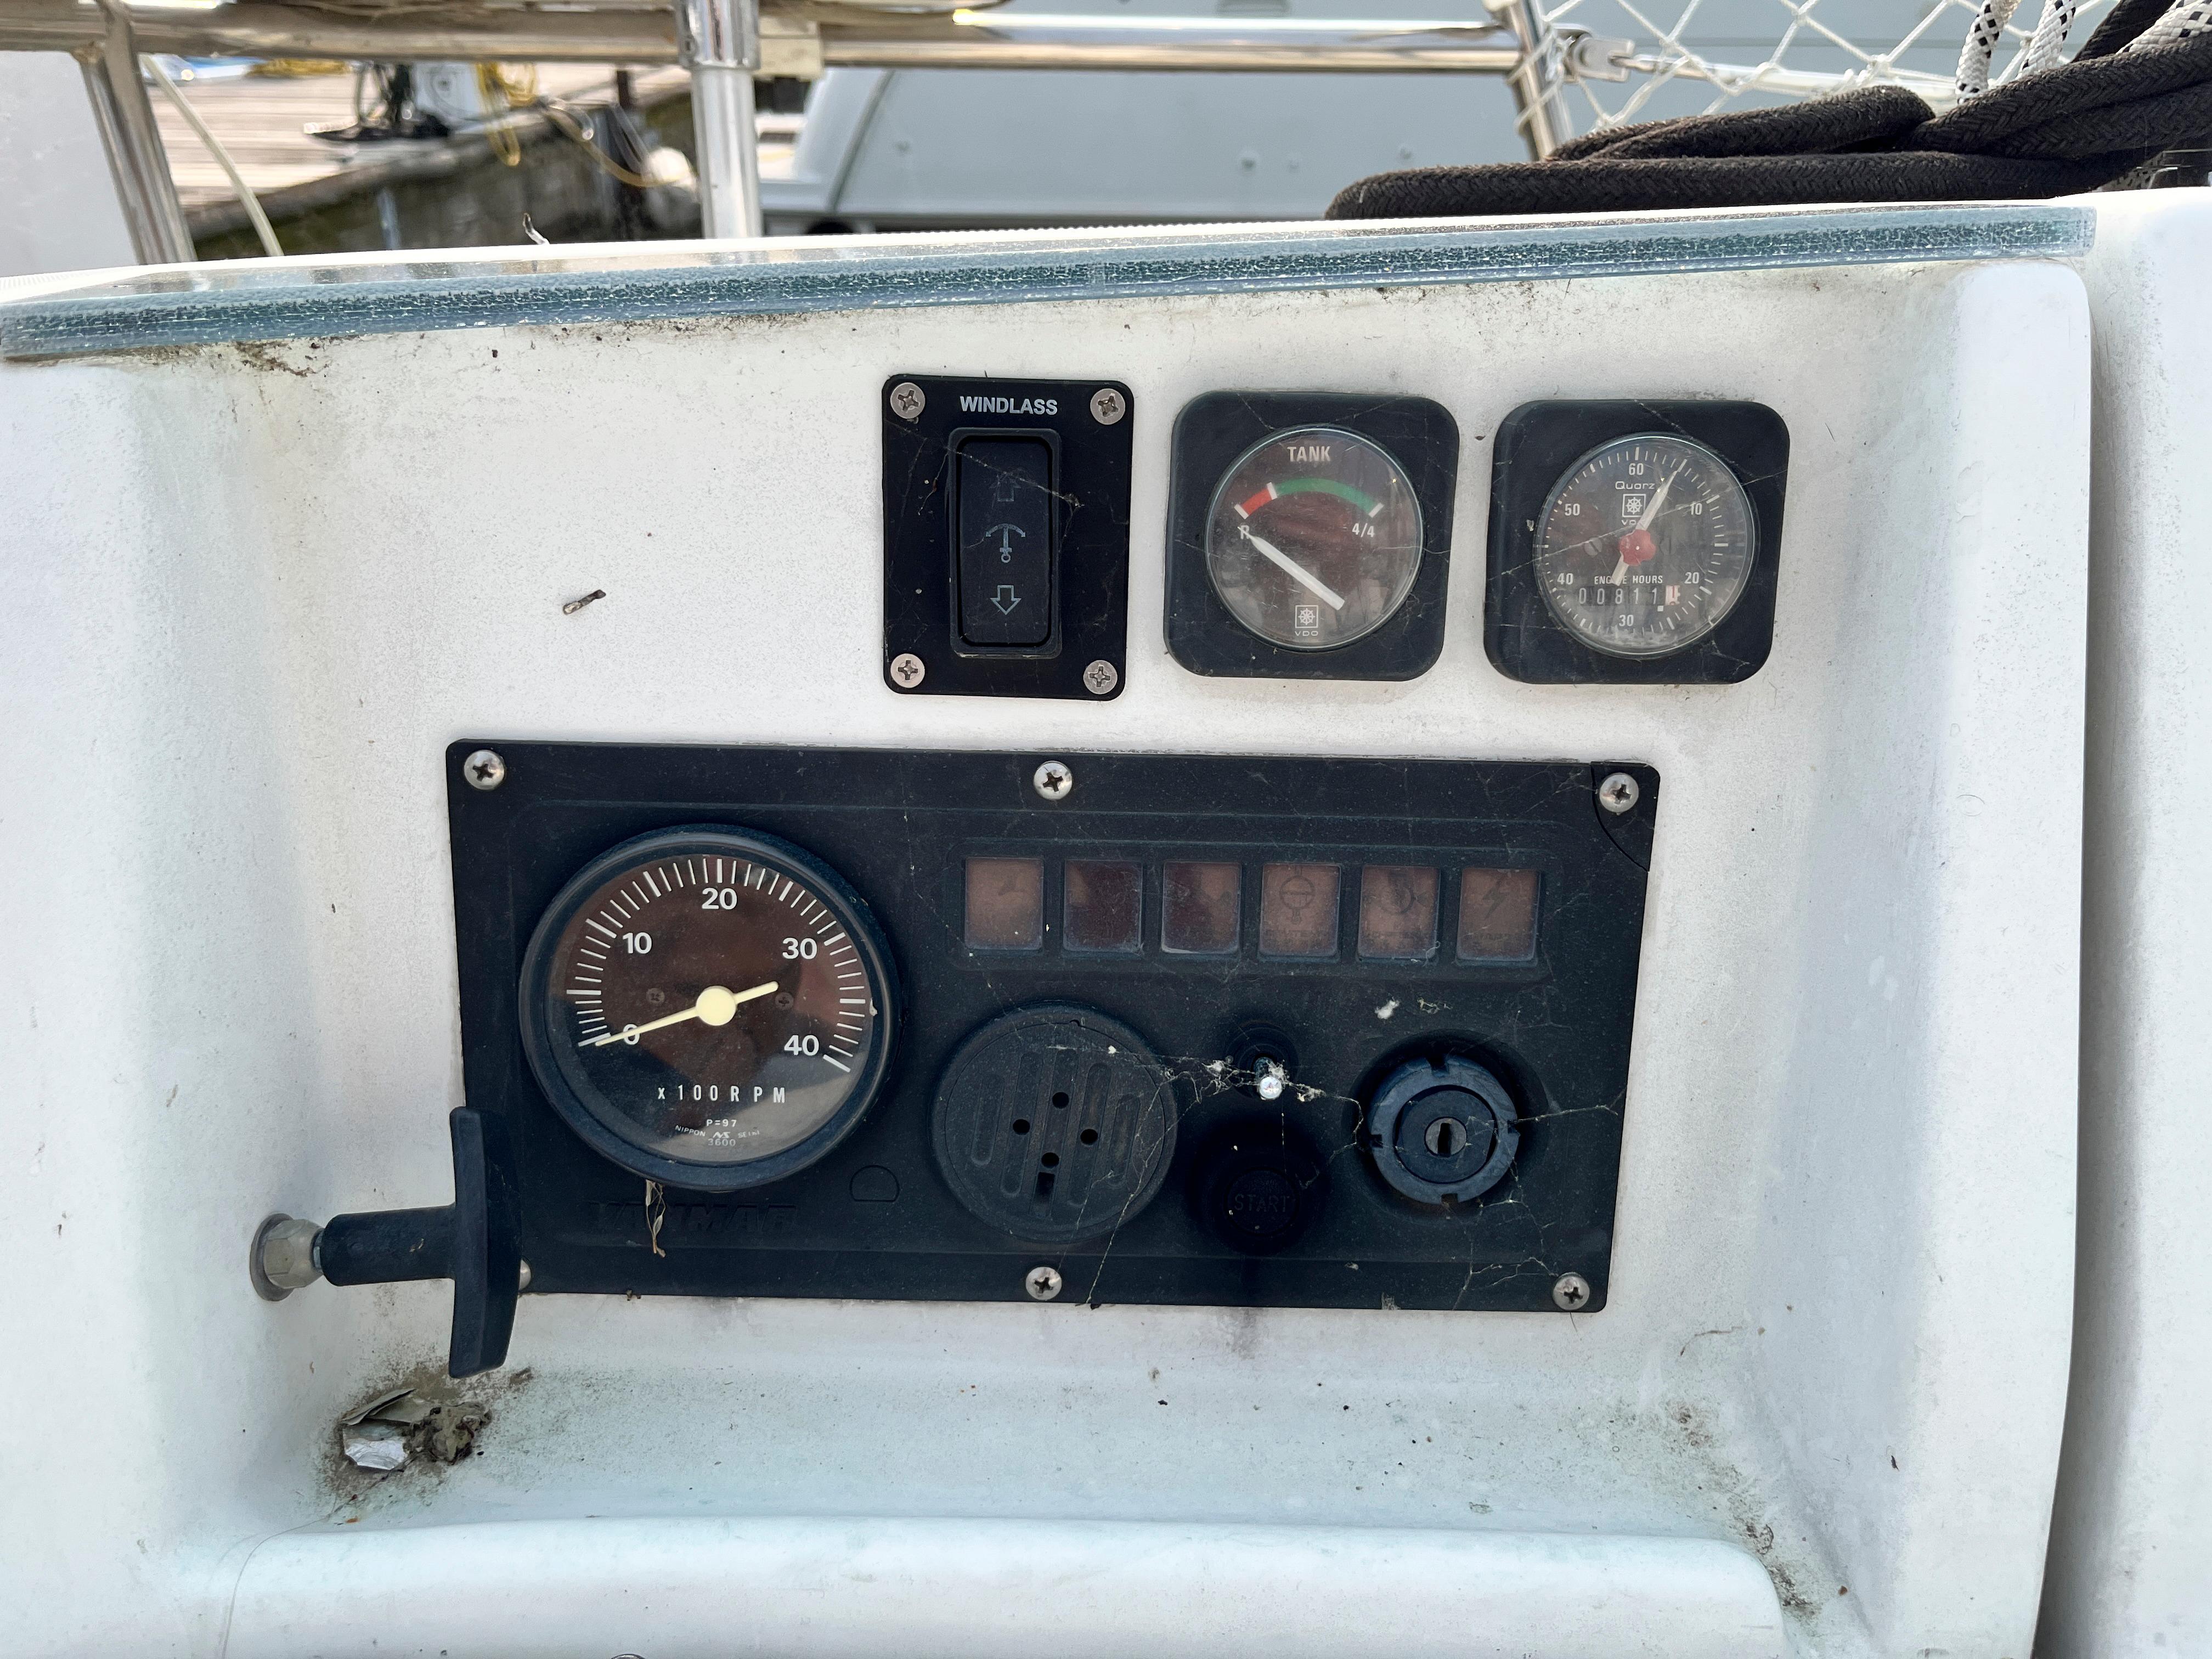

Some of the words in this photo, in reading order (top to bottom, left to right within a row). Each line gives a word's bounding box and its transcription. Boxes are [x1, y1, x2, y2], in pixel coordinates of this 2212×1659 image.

[960, 396, 1058, 415] WINDLASS
[1287, 445, 1331, 462] TANK
[1628, 462, 1644, 476] 60
[1615, 481, 1655, 490] Quarz
[1565, 503, 1580, 516] 50
[1690, 501, 1702, 515] 10
[1352, 523, 1375, 538] 4/4
[1557, 573, 1574, 585] 40
[1594, 575, 1627, 584] ENGE
[1632, 575, 1663, 584] HOURS
[1684, 572, 1700, 585] 20
[1618, 614, 1634, 627] 30
[701, 887, 738, 910] 20
[622, 932, 653, 954] 10
[782, 937, 818, 960] 30
[784, 1035, 820, 1056] 40
[706, 1119, 737, 1127] P=97
[675, 1124, 707, 1137] NIPPON
[708, 1138, 736, 1147] 3600
[1234, 1193, 1290, 1213] START
